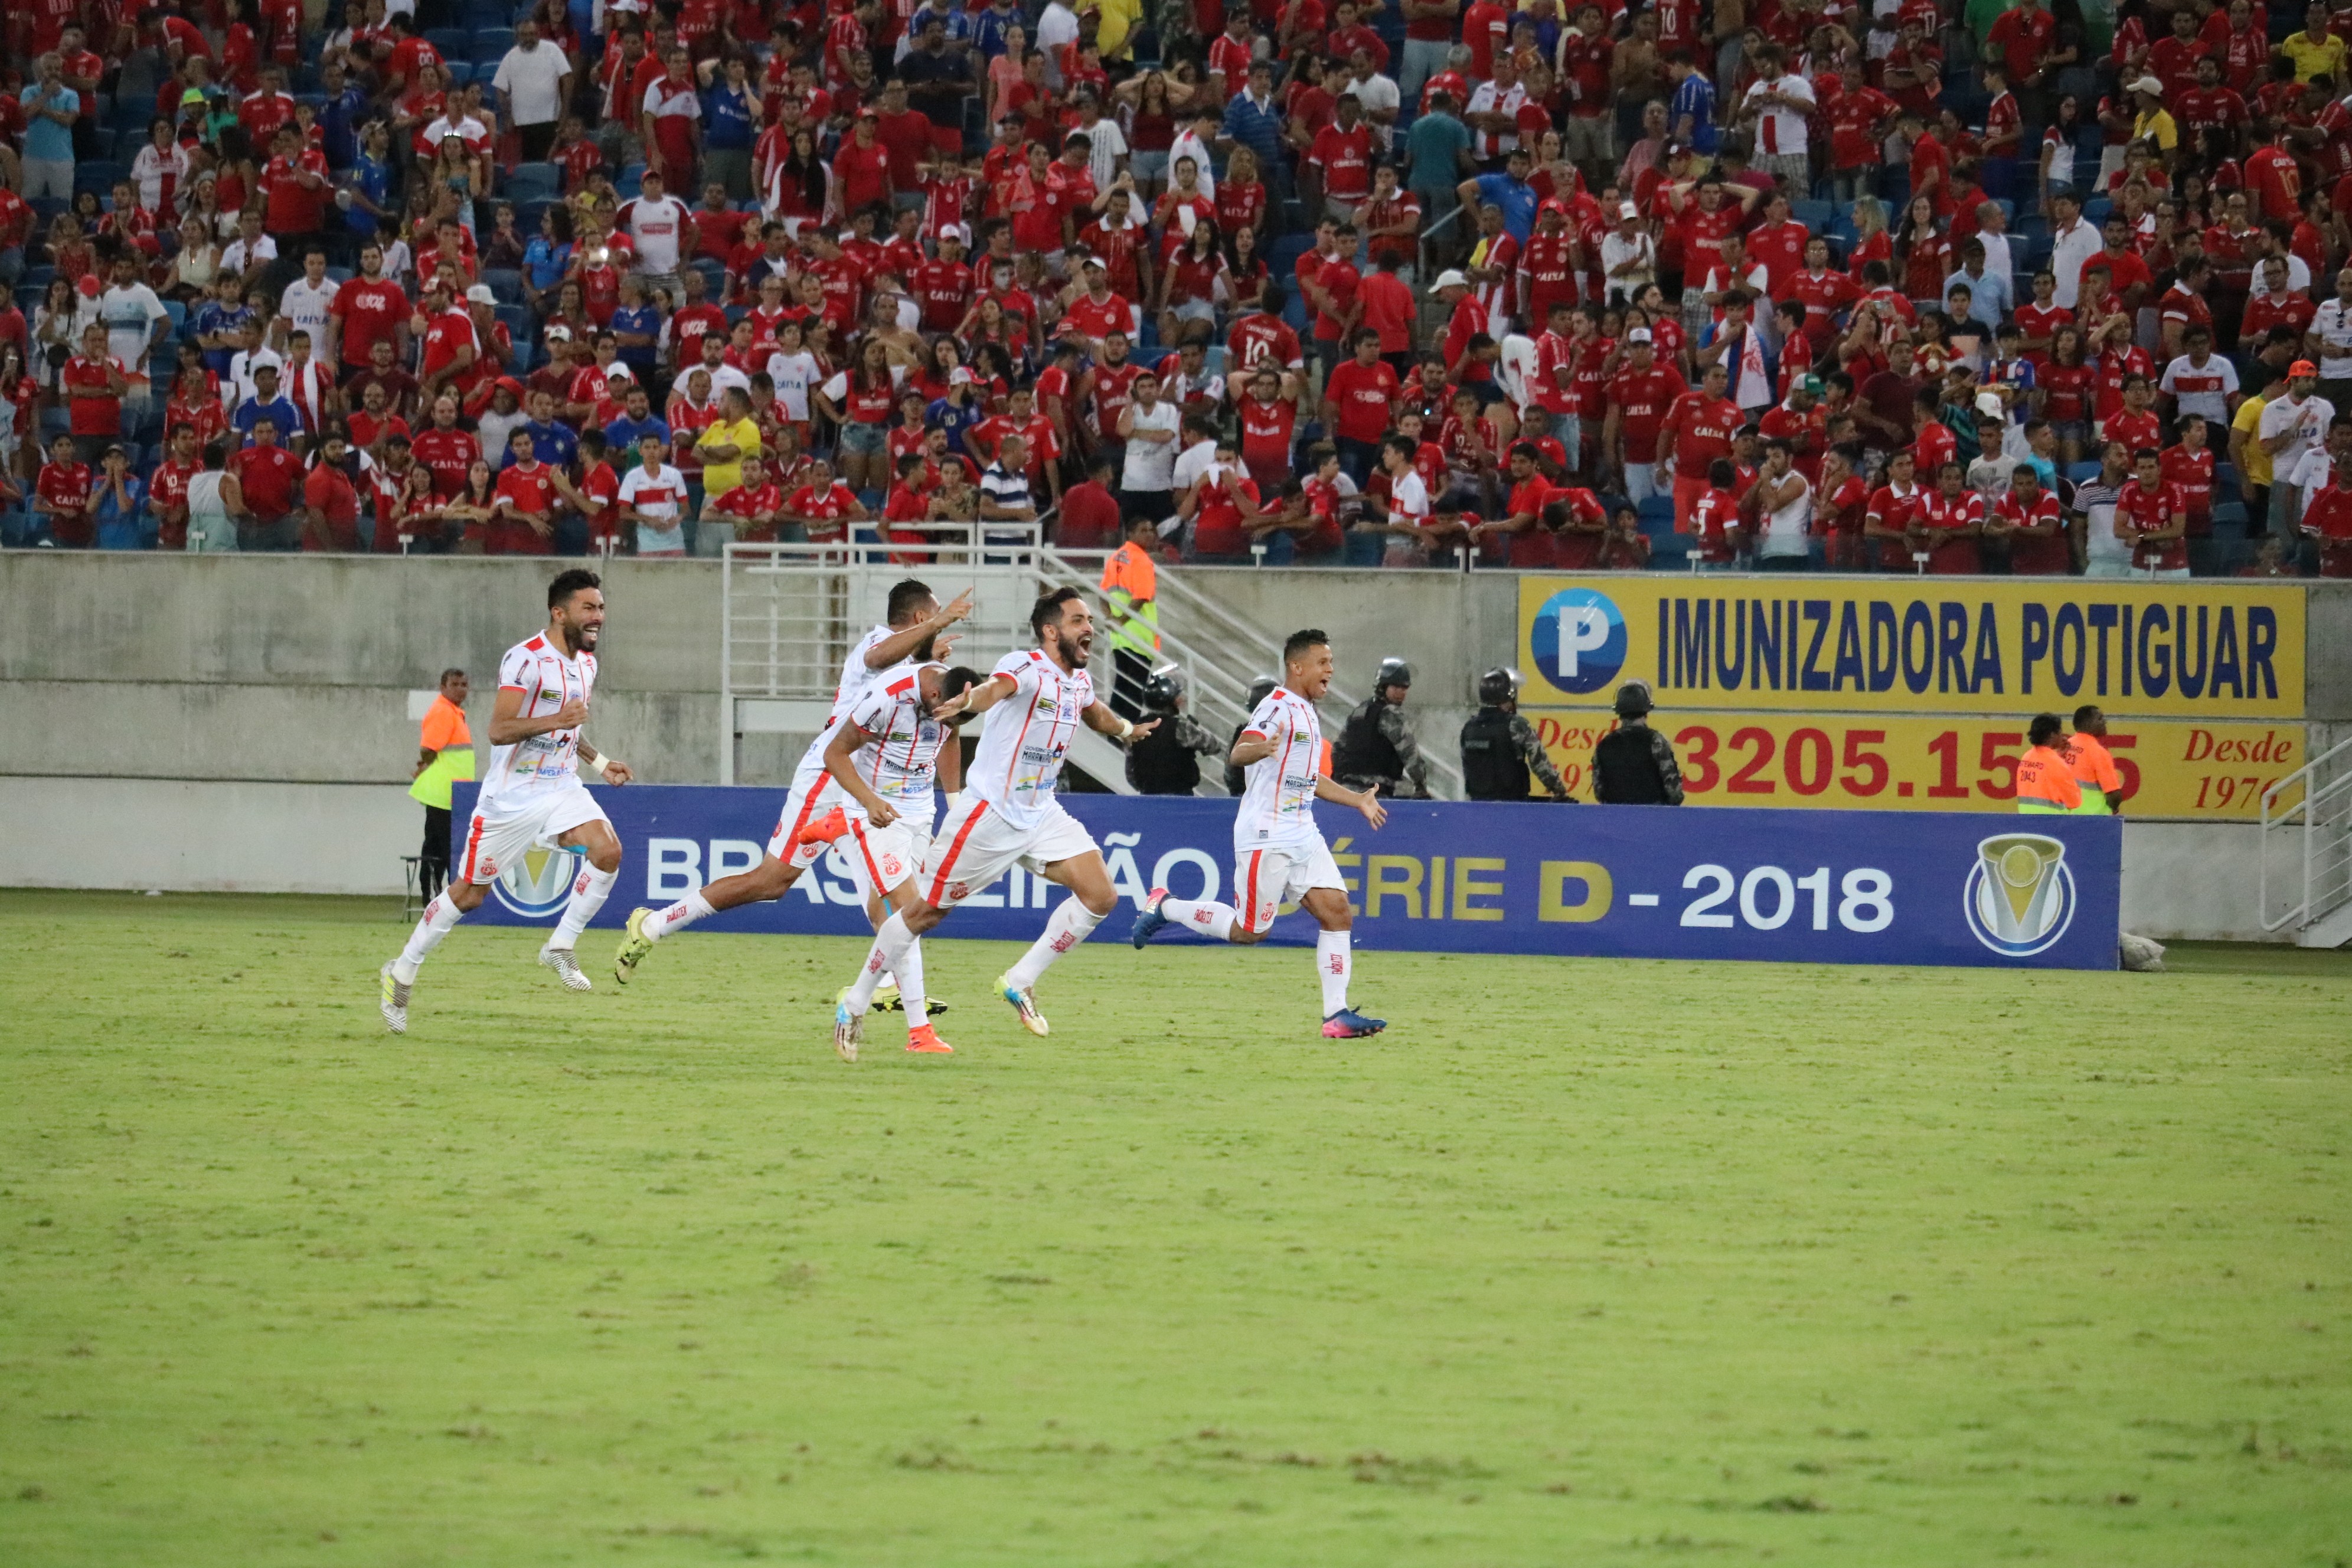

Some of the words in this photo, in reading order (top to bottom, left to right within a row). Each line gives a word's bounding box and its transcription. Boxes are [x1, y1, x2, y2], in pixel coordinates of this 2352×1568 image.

[1660, 7, 1678, 34] 10
[1245, 337, 1269, 364] 10
[593, 381, 604, 392] 10
[166, 475, 178, 488] 10
[1559, 606, 1609, 678] P
[1659, 598, 2003, 694] IMUNIZADORA
[2022, 603, 2279, 699] POTIGUAR
[1537, 717, 1619, 750] Desd
[2183, 729, 2292, 763] Desde
[1675, 726, 2141, 801] 3205.155
[2192, 776, 2279, 809] 1976
[1276, 837, 1505, 922] ÉRIE
[1537, 860, 1613, 923] D
[1680, 864, 1894, 933] 2018
